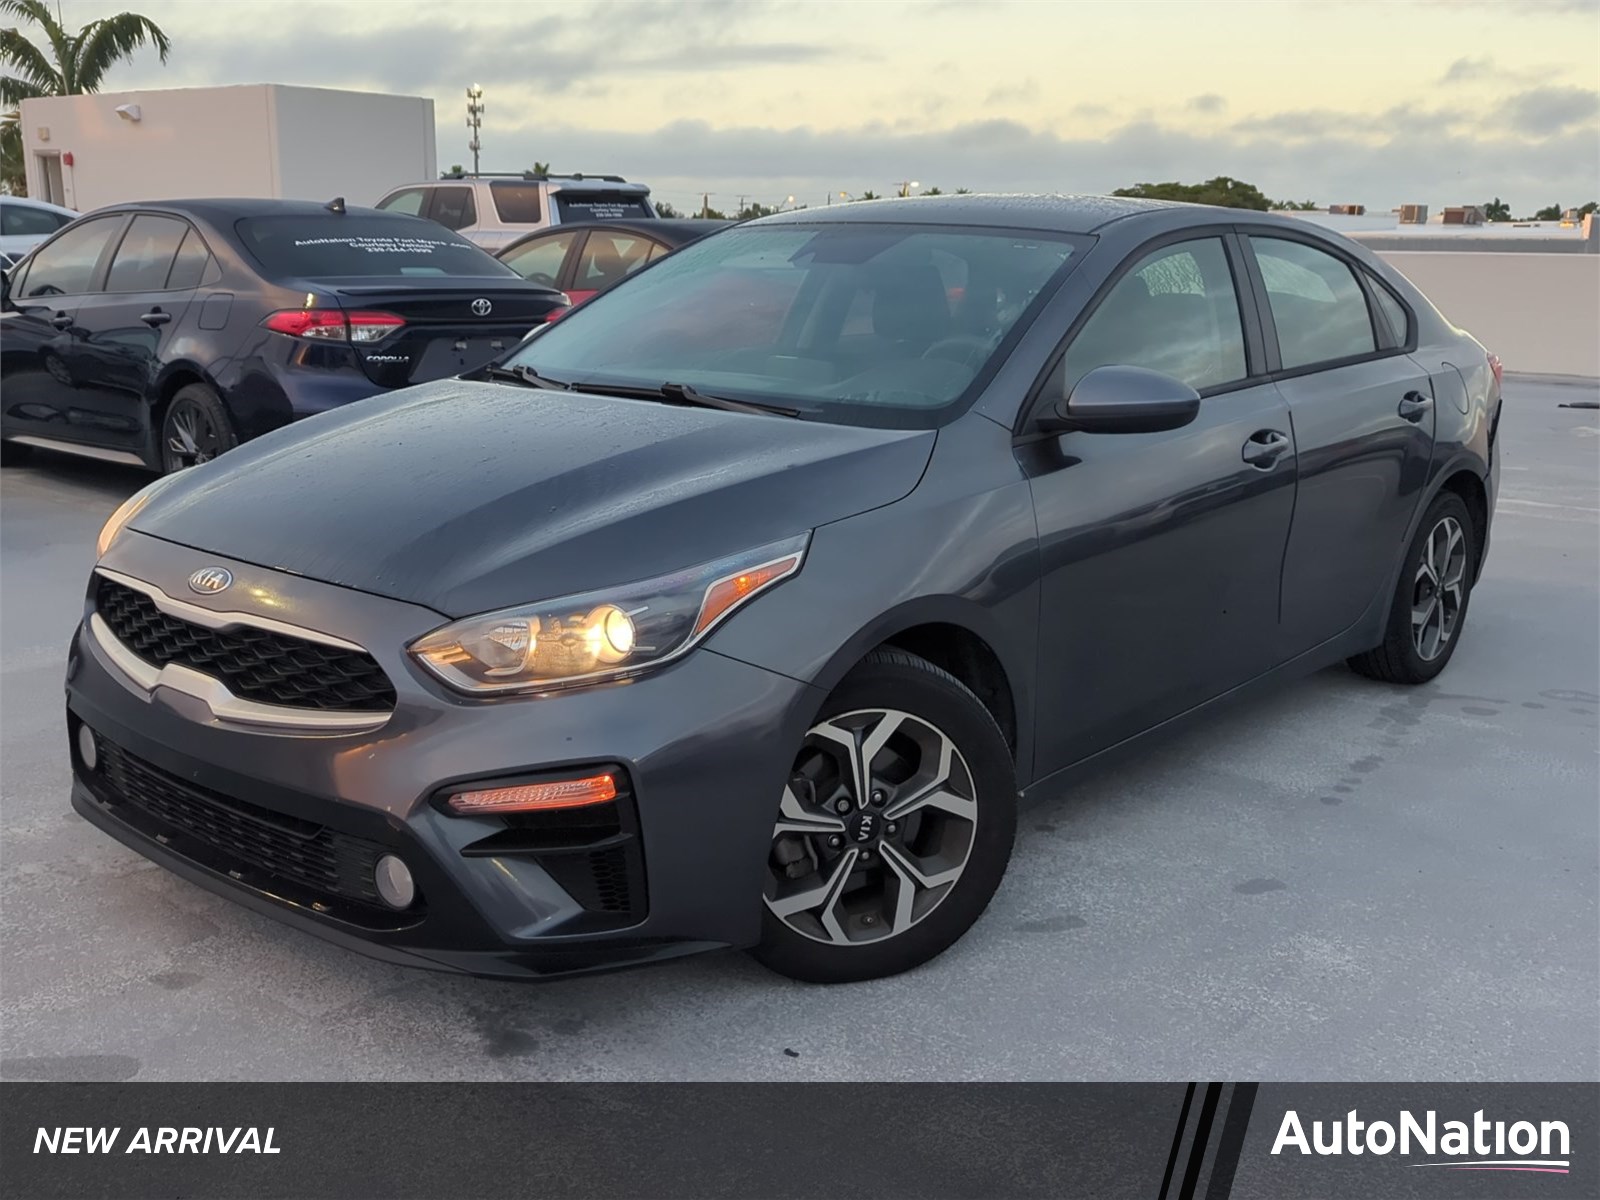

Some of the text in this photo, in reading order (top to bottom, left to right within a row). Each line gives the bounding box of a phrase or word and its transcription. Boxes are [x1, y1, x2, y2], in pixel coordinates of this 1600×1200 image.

[295, 237, 356, 247] AutoNation
[356, 236, 393, 244] Toyota
[192, 570, 224, 589] KIA
[858, 815, 873, 840] KIA
